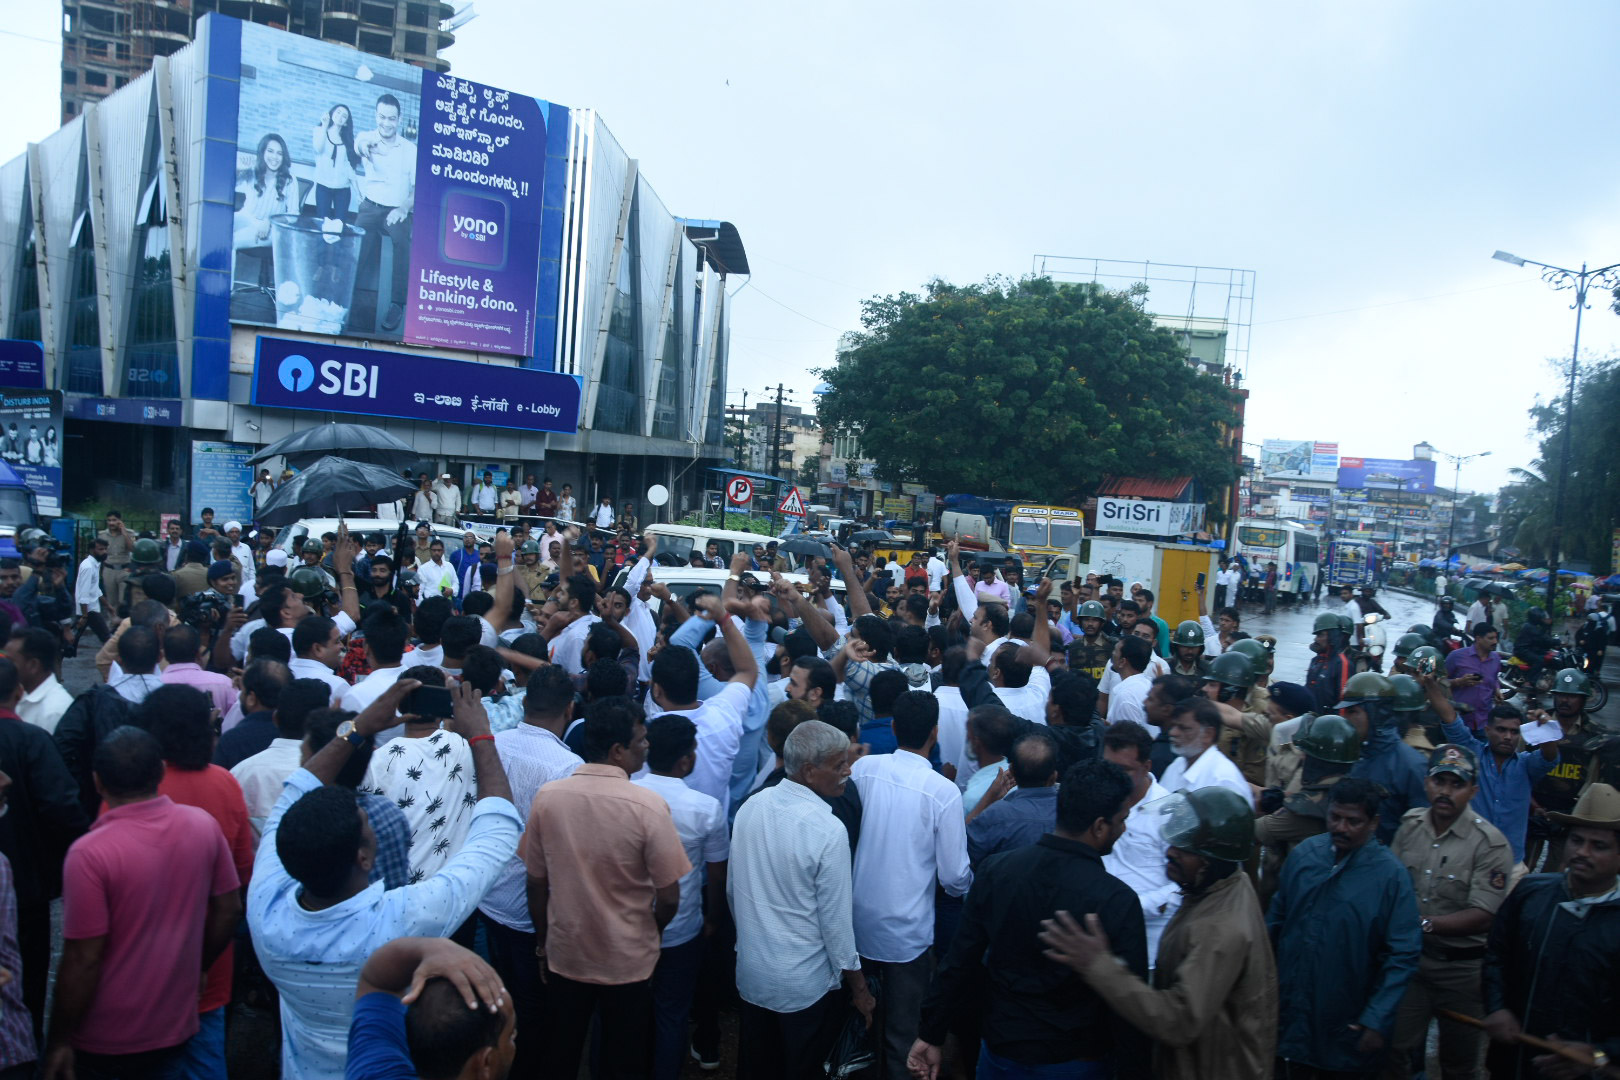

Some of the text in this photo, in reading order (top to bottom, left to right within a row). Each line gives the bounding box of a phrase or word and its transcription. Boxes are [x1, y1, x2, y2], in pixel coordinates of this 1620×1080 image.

[431, 143, 490, 167] ಮಾಡಿಬಿಡಿರಿ
[453, 214, 498, 236] yono
[461, 231, 486, 242] by SBI
[420, 268, 494, 293] Lifestyle &
[419, 285, 518, 312] banking, dono.
[317, 358, 379, 399] SBI
[4, 396, 51, 407] DISTURB INDIA
[735, 481, 748, 499] P
